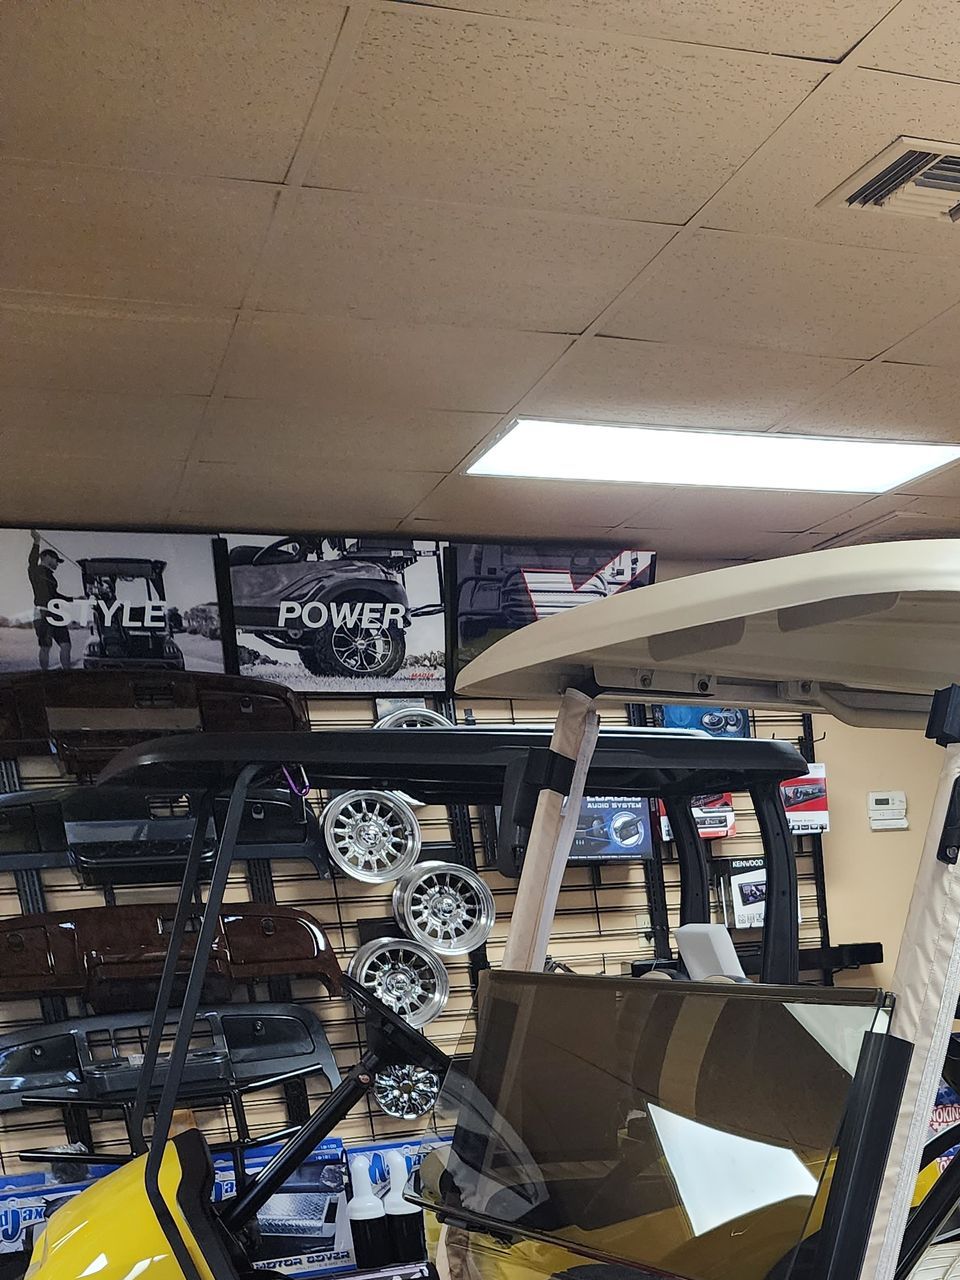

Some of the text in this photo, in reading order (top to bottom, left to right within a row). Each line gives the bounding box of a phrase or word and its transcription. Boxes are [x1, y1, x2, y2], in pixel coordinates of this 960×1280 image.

[46, 598, 165, 627] STYLE
[278, 601, 406, 629] POWER
[611, 801, 642, 809] SYSTEM
[732, 859, 764, 868] KENWOOD
[255, 1257, 303, 1270] MOTOR
[306, 1250, 350, 1263] COVER
